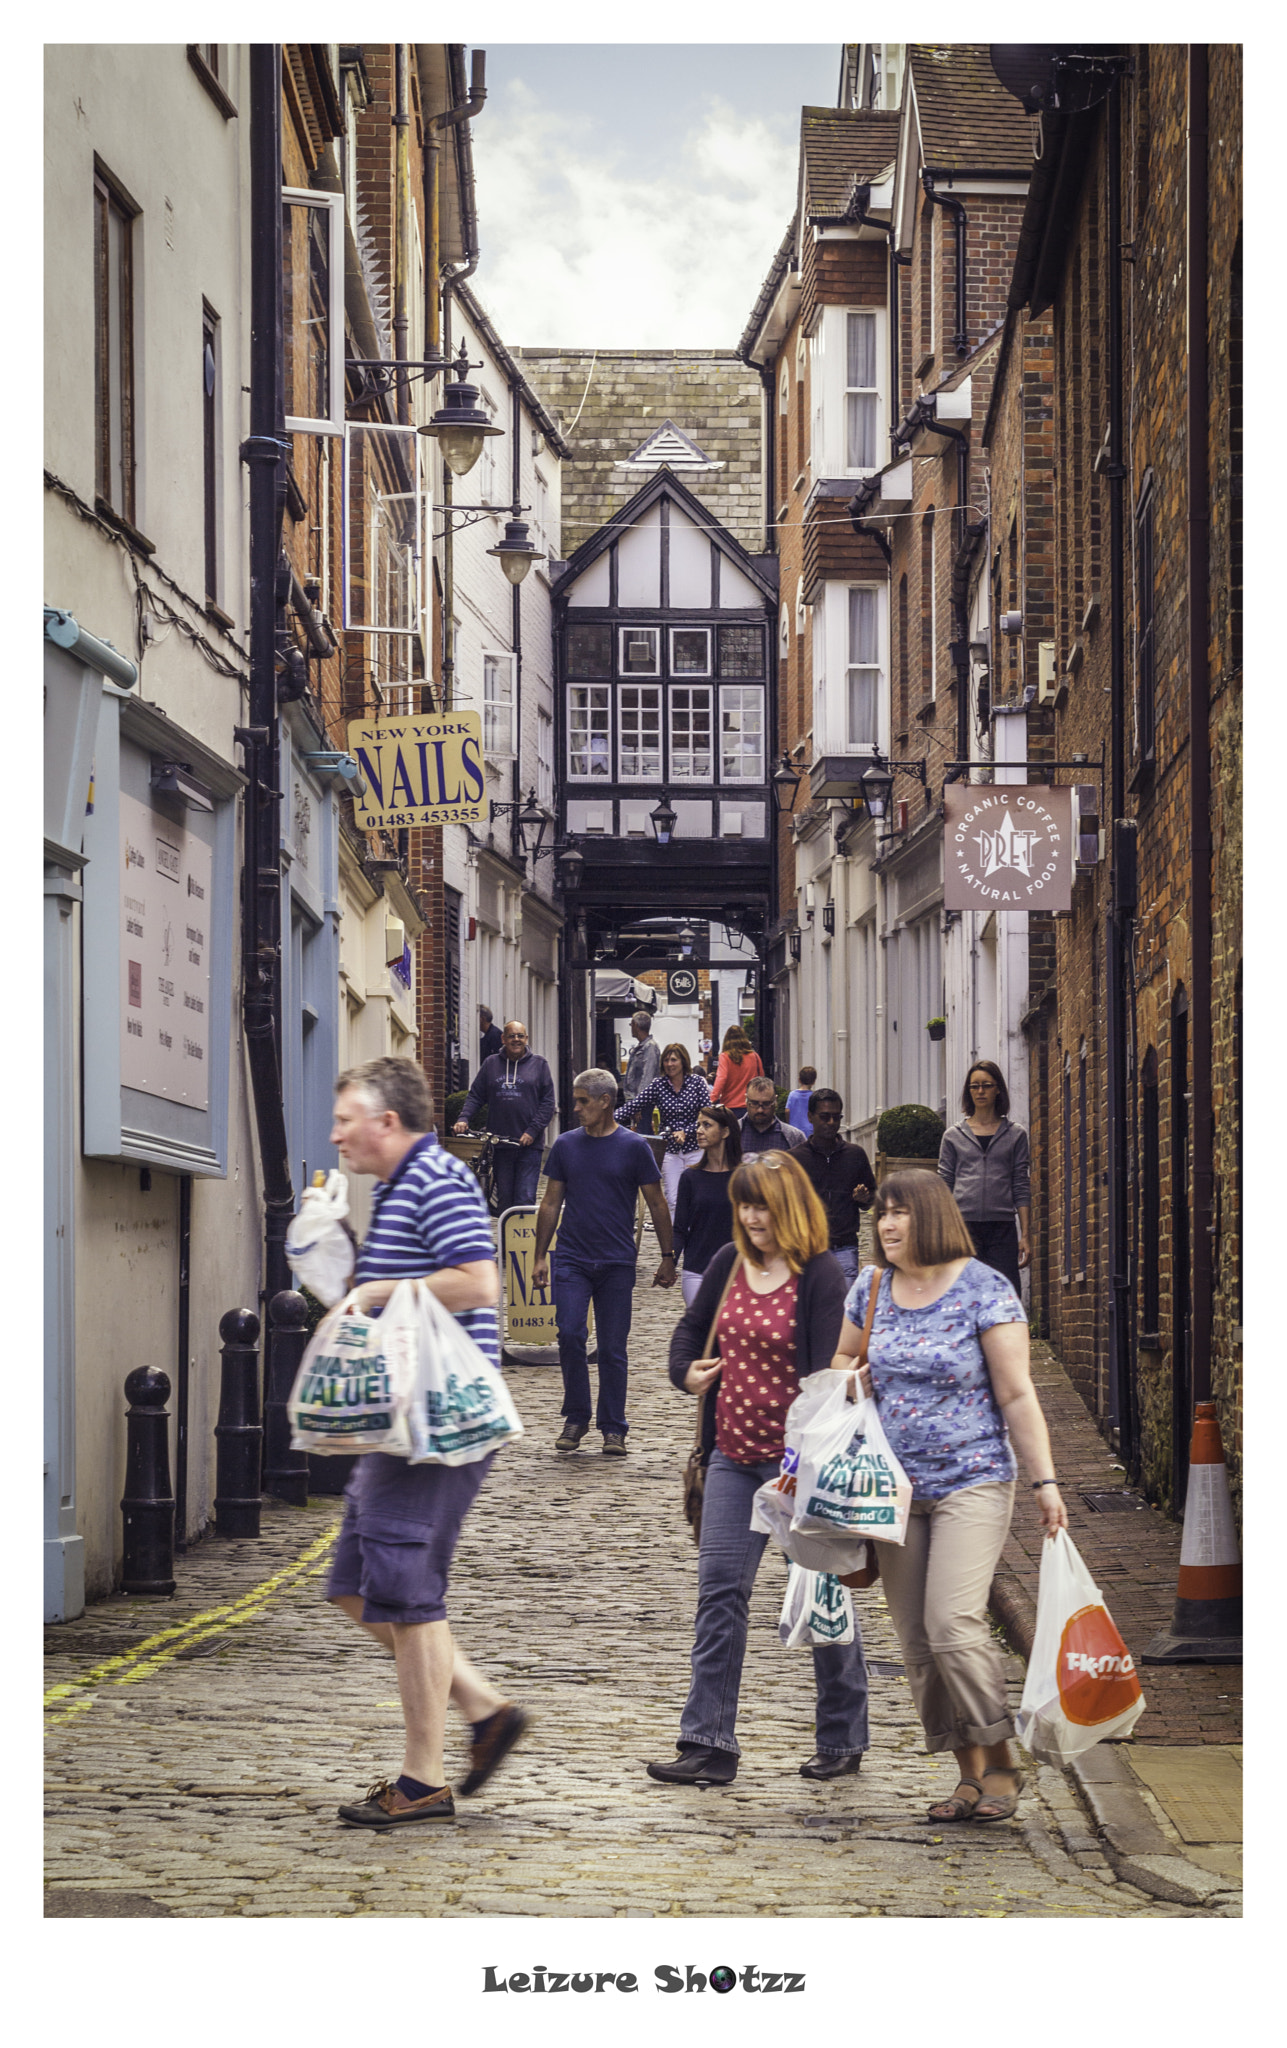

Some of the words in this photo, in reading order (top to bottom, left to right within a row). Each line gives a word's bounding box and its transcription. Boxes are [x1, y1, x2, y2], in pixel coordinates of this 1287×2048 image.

[360, 728, 407, 742] NEW
[412, 723, 472, 738] YORK
[353, 737, 484, 812] NAILS
[366, 813, 415, 828] 01483
[420, 808, 480, 823] 453355
[954, 794, 1009, 842] ORGANIC
[1016, 796, 1060, 842] COFFEE
[980, 829, 1036, 868] PRET
[958, 863, 1021, 901] NATURAL
[1026, 862, 1057, 895] FOOD
[512, 1317, 544, 1328] 01483
[814, 1502, 876, 1522] Poundland
